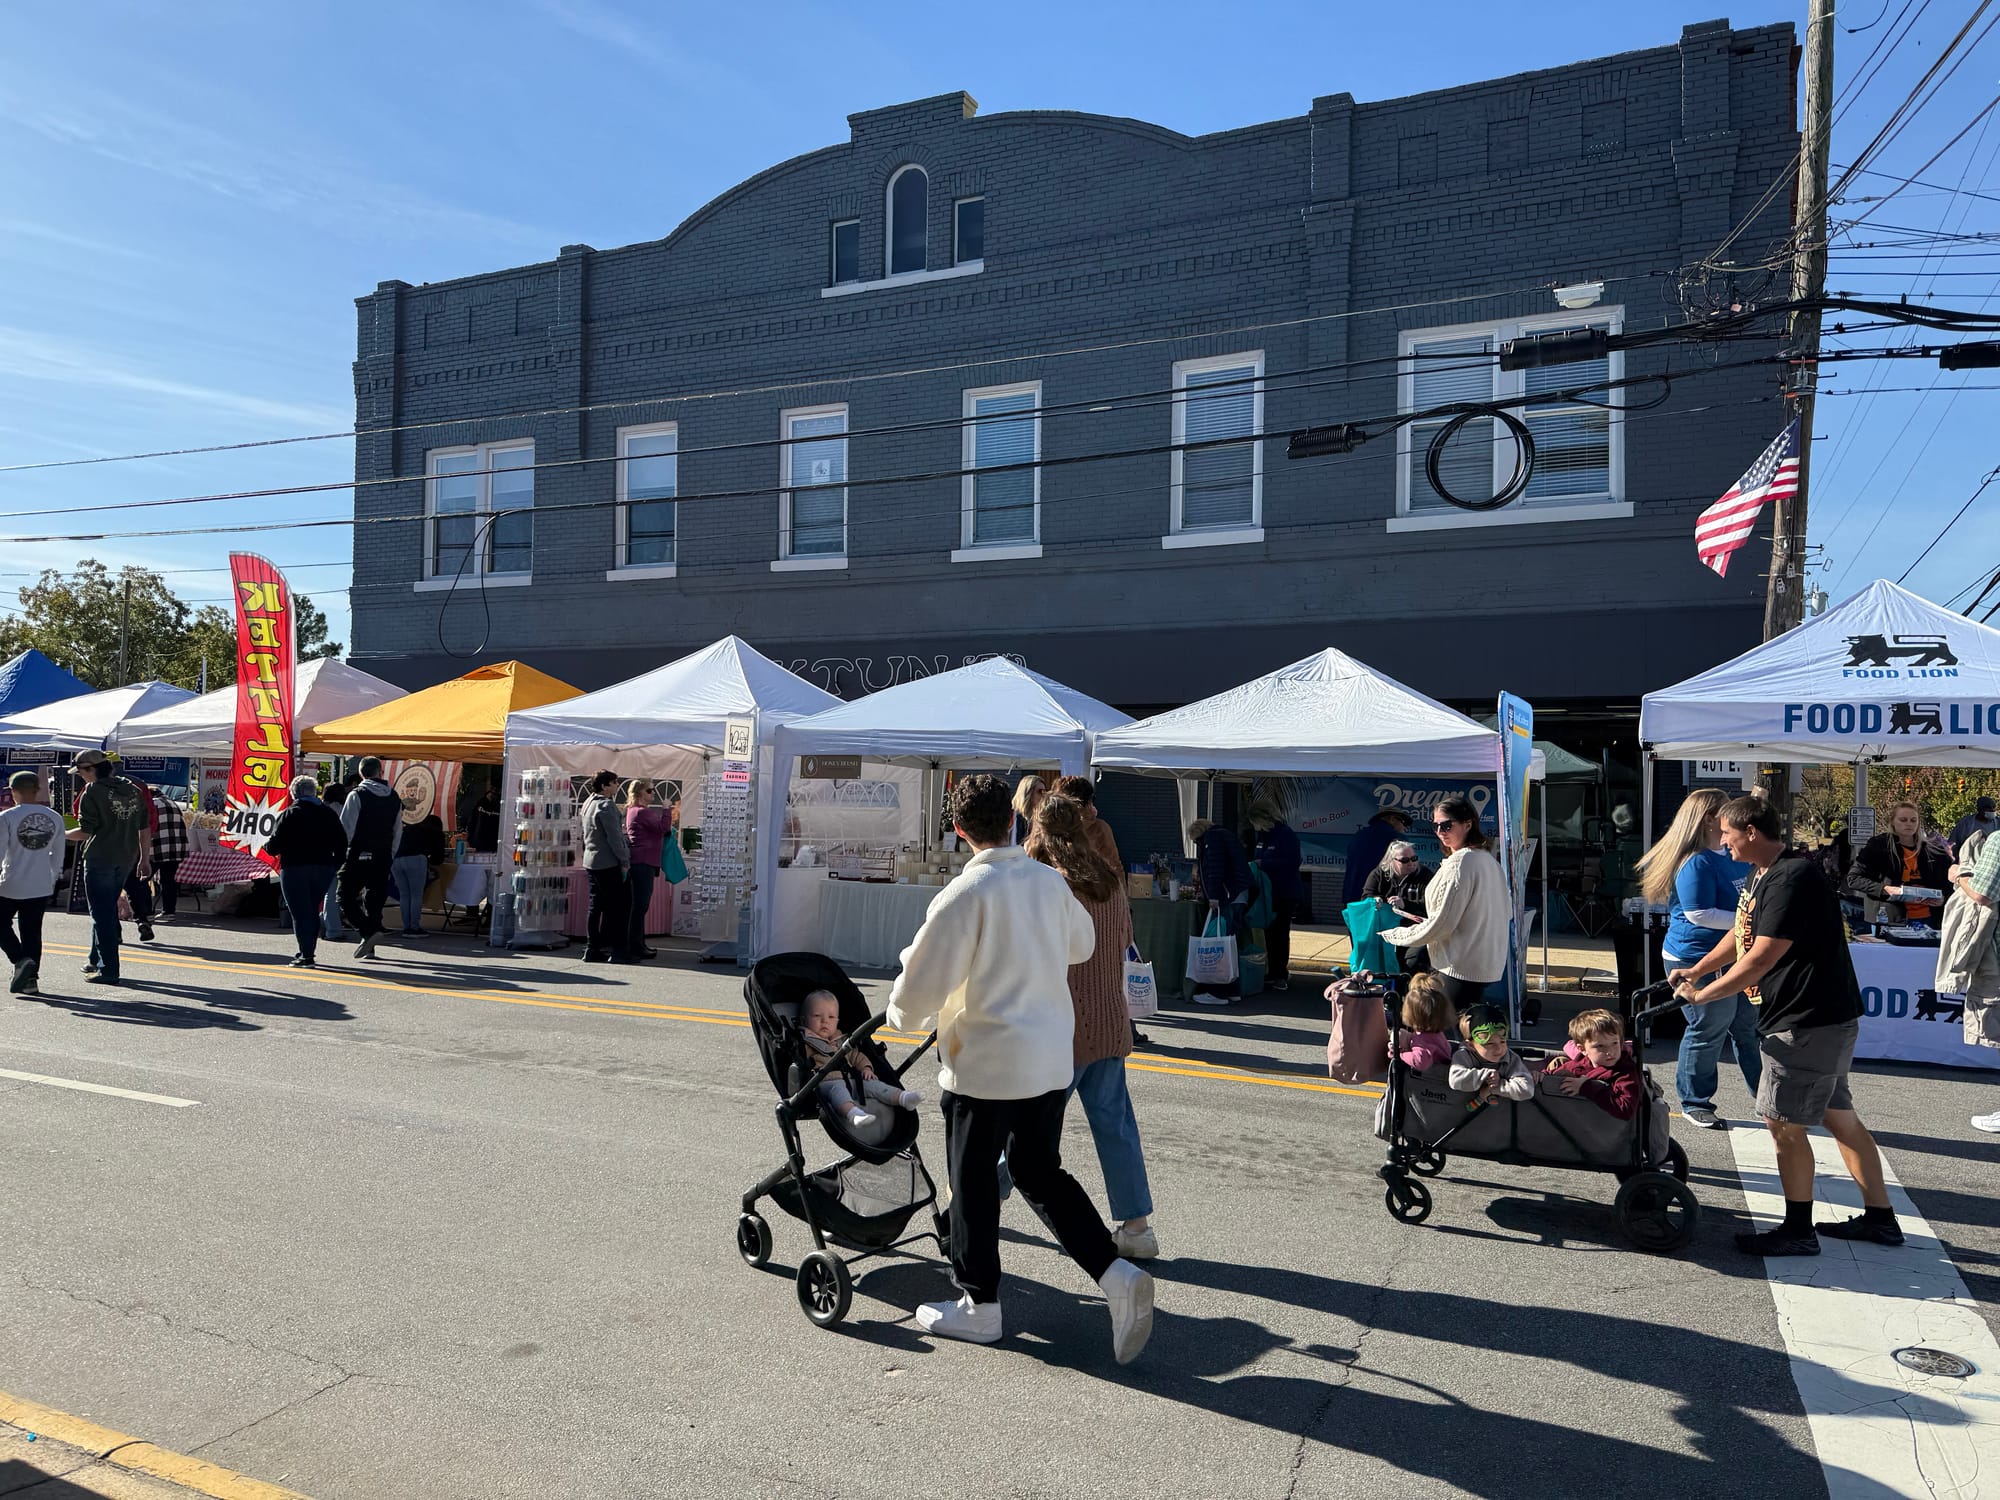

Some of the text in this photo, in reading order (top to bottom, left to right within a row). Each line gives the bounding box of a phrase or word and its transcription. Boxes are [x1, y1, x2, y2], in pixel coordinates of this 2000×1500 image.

[1842, 668, 1959, 679] FOOD LION
[1784, 703, 2000, 735] FOOD LIO
[1701, 760, 1723, 772] 401
[206, 769, 230, 780] MONS
[1861, 986, 1909, 1019] OD
[1420, 1089, 1447, 1102] Jeep
